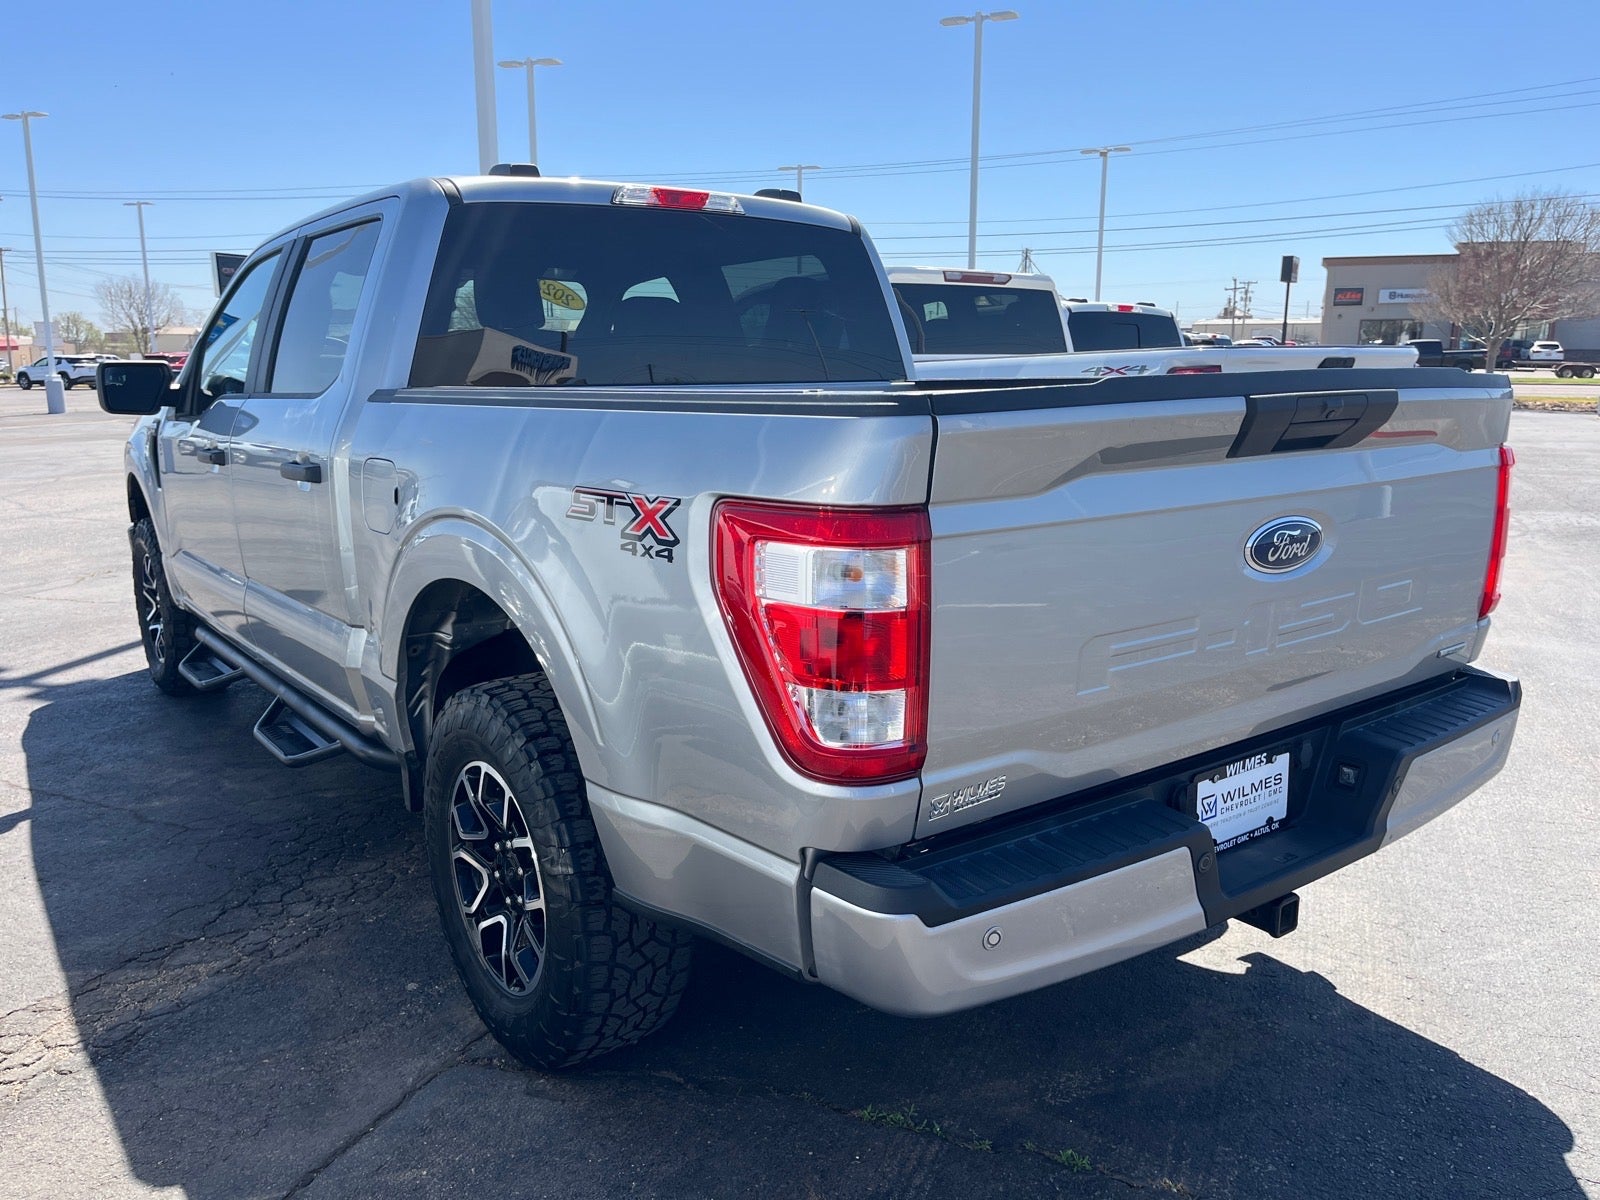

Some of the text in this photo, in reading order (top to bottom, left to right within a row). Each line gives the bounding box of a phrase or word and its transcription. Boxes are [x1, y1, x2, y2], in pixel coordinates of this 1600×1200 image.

[565, 485, 682, 548] STX
[1267, 529, 1312, 562] Ford
[1076, 568, 1427, 697] F-150
[1226, 752, 1268, 778] WILMES
[952, 774, 1007, 806] WILMES
[1220, 786, 1283, 815] CHEVROLET GMC
[1221, 772, 1283, 805] WILMES
[1214, 838, 1236, 853] EVROLET
[1237, 833, 1250, 844] GMC
[1271, 822, 1280, 830] OK
